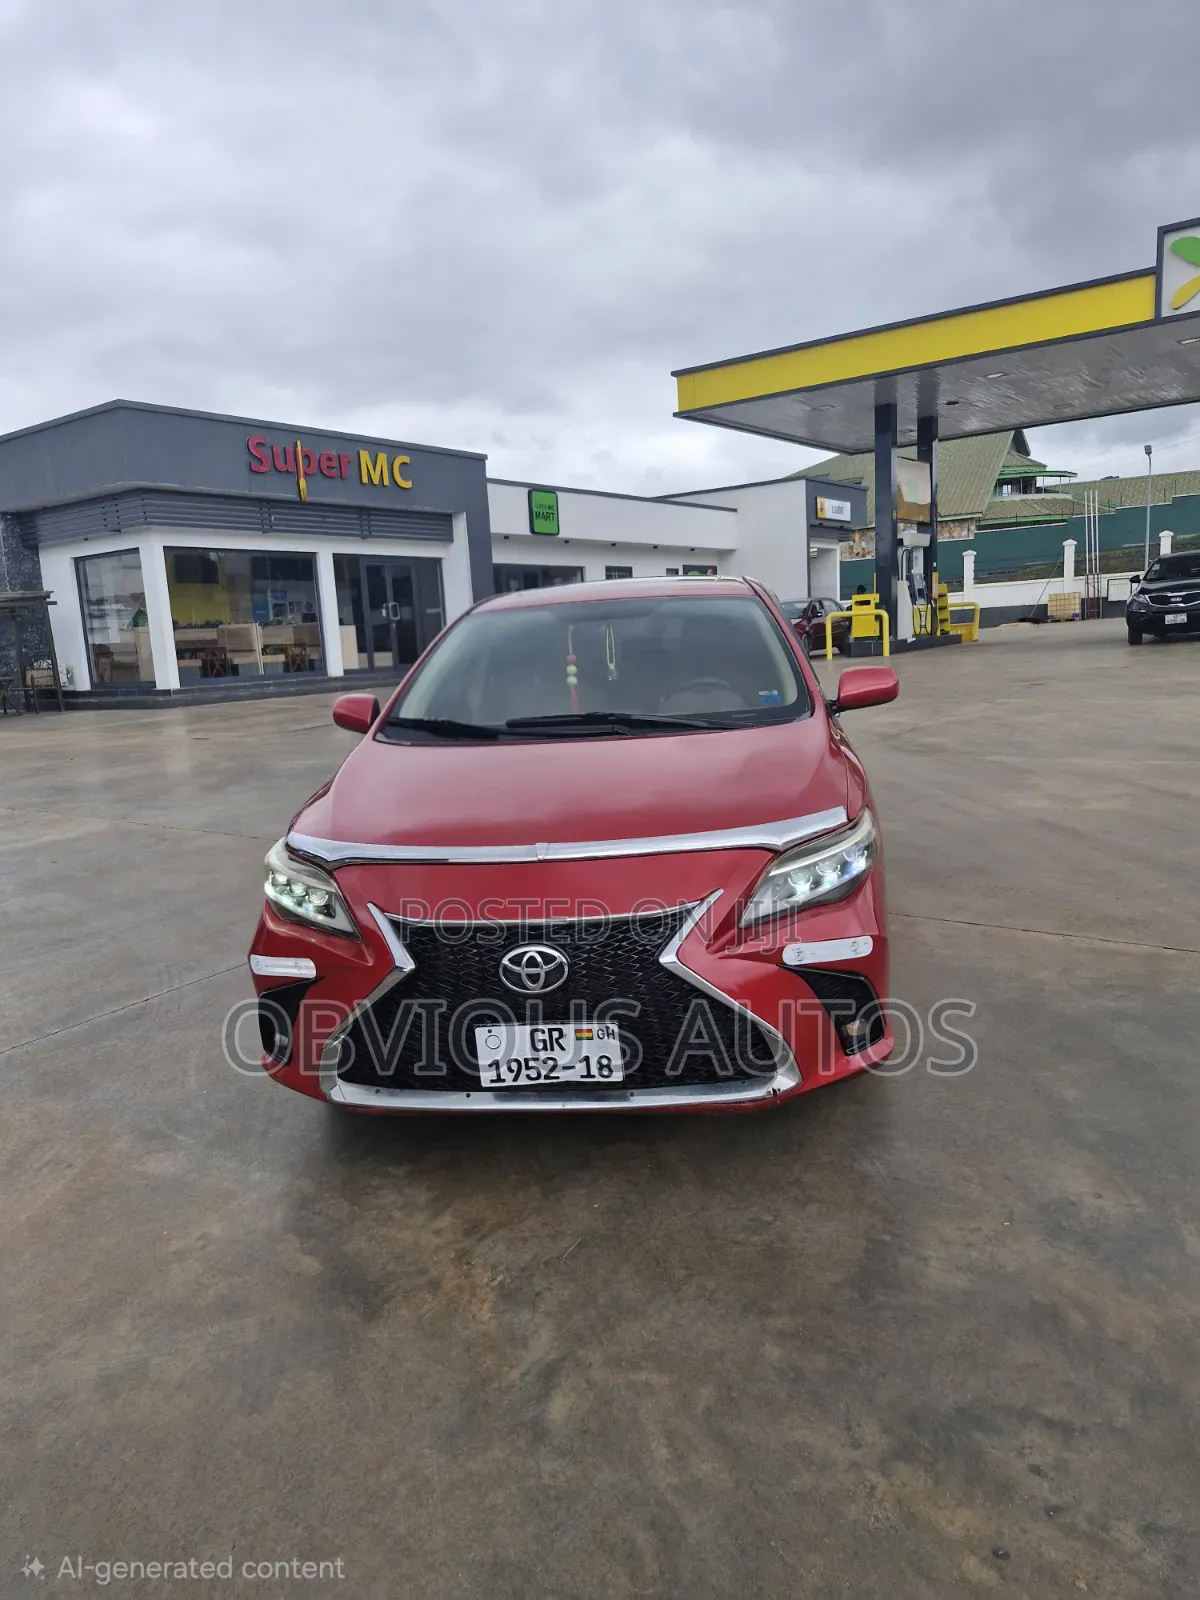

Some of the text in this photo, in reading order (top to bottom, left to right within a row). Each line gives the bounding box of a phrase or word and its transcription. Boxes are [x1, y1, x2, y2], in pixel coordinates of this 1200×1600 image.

[247, 434, 413, 489] Super MC
[535, 511, 555, 522] MART
[832, 504, 844, 515] LUBE
[530, 1027, 616, 1052] GR GH
[488, 1055, 613, 1083] 1952-18
